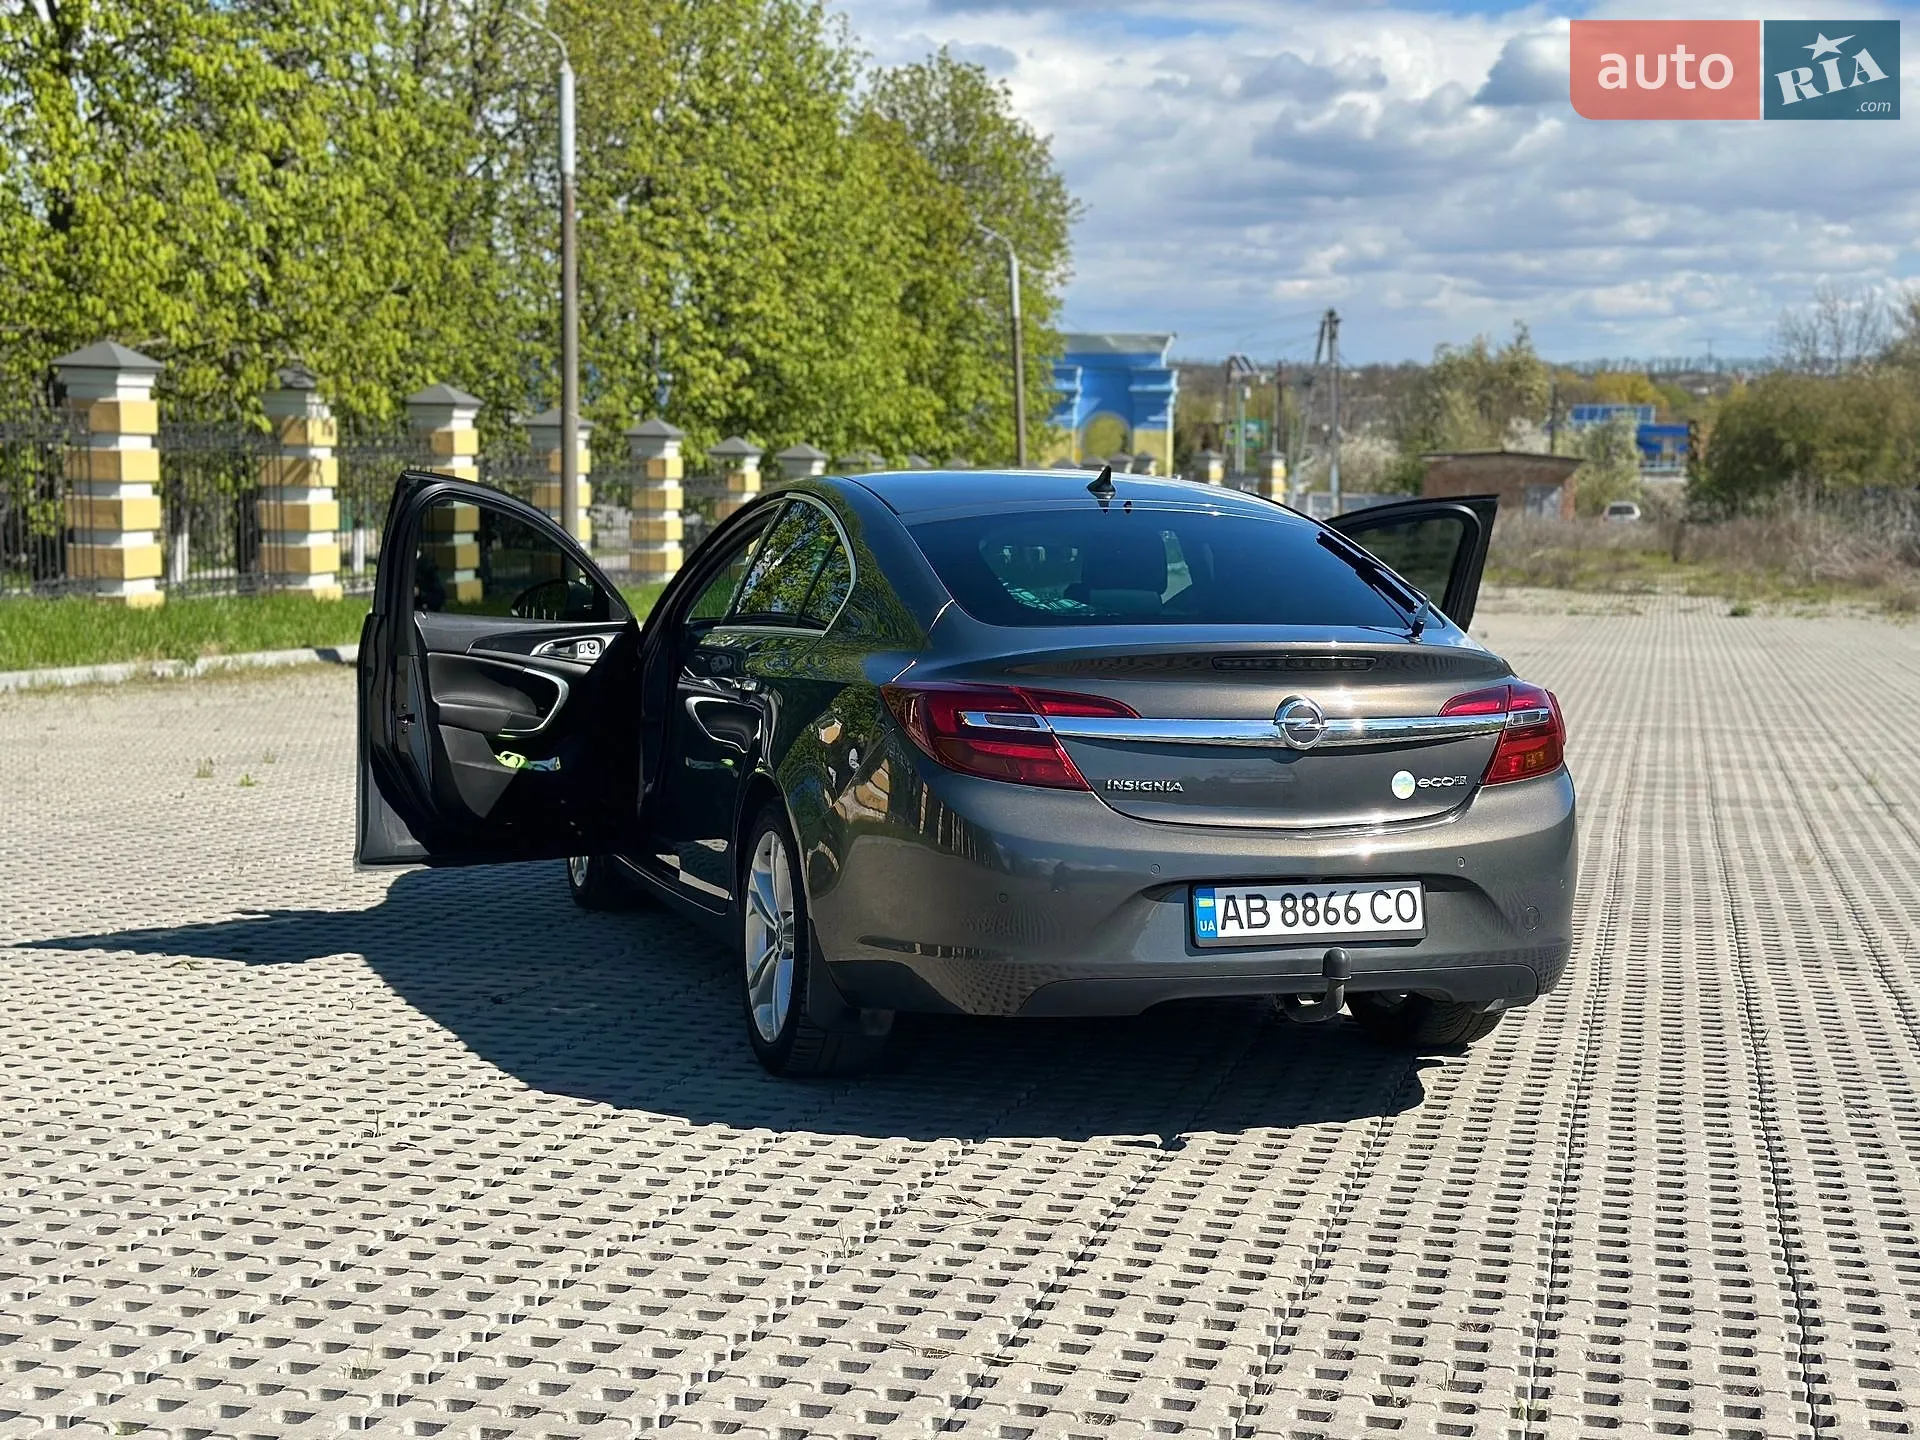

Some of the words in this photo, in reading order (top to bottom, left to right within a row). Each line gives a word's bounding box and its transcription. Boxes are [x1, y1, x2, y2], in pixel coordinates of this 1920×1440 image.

[1106, 779, 1184, 792] INSIGNIA
[1220, 894, 1271, 931] AB
[1280, 890, 1361, 928] 8866
[1370, 889, 1418, 924] CO
[1200, 919, 1216, 932] UA
